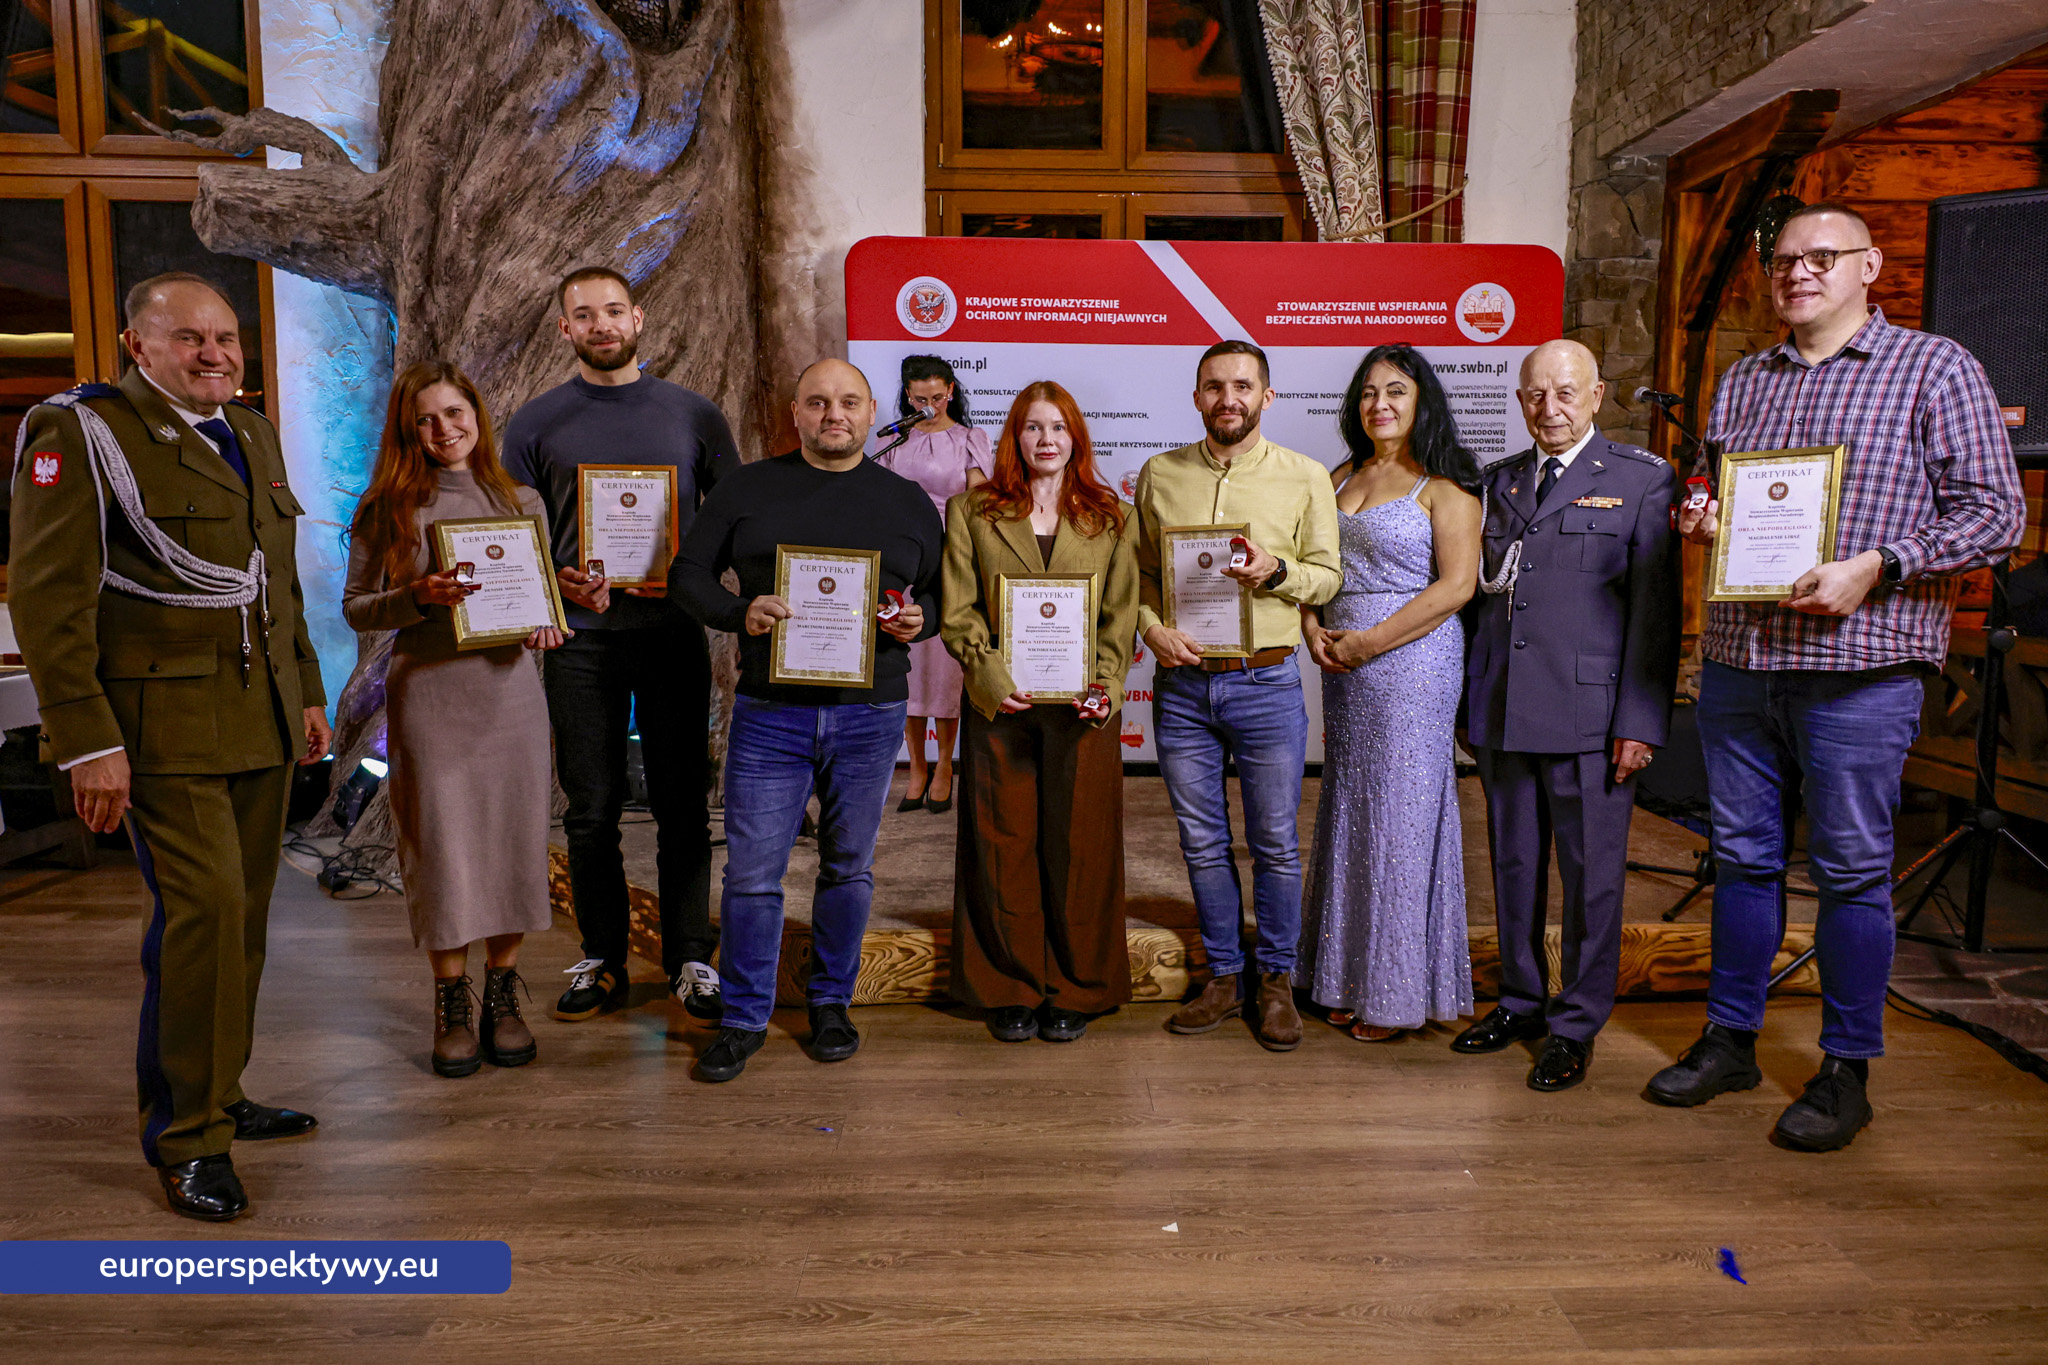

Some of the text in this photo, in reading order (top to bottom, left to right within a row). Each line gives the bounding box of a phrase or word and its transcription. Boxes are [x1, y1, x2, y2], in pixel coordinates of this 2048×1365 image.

[965, 297, 1120, 309] KRAJOWE STOWARZYSZENIE
[1276, 302, 1448, 311] STOWARZYSZENIE WSPIERANIA
[965, 310, 1168, 324] OCHRONY INFORMACJI NIEJAWNYCH
[1265, 314, 1447, 324] BEZPIECZEŃSTWA NARODOWEGO
[1472, 400, 1507, 408] wspieramy
[1102, 412, 1149, 420] NIEJAWNYCH,
[1748, 468, 1814, 480] CERTYFIKAT
[602, 482, 654, 490] CERTYFIKAT
[462, 534, 520, 544] CERTYFIKAT
[1182, 541, 1228, 550] CERTYFIKAT
[800, 564, 856, 574] CERTYFIKAT
